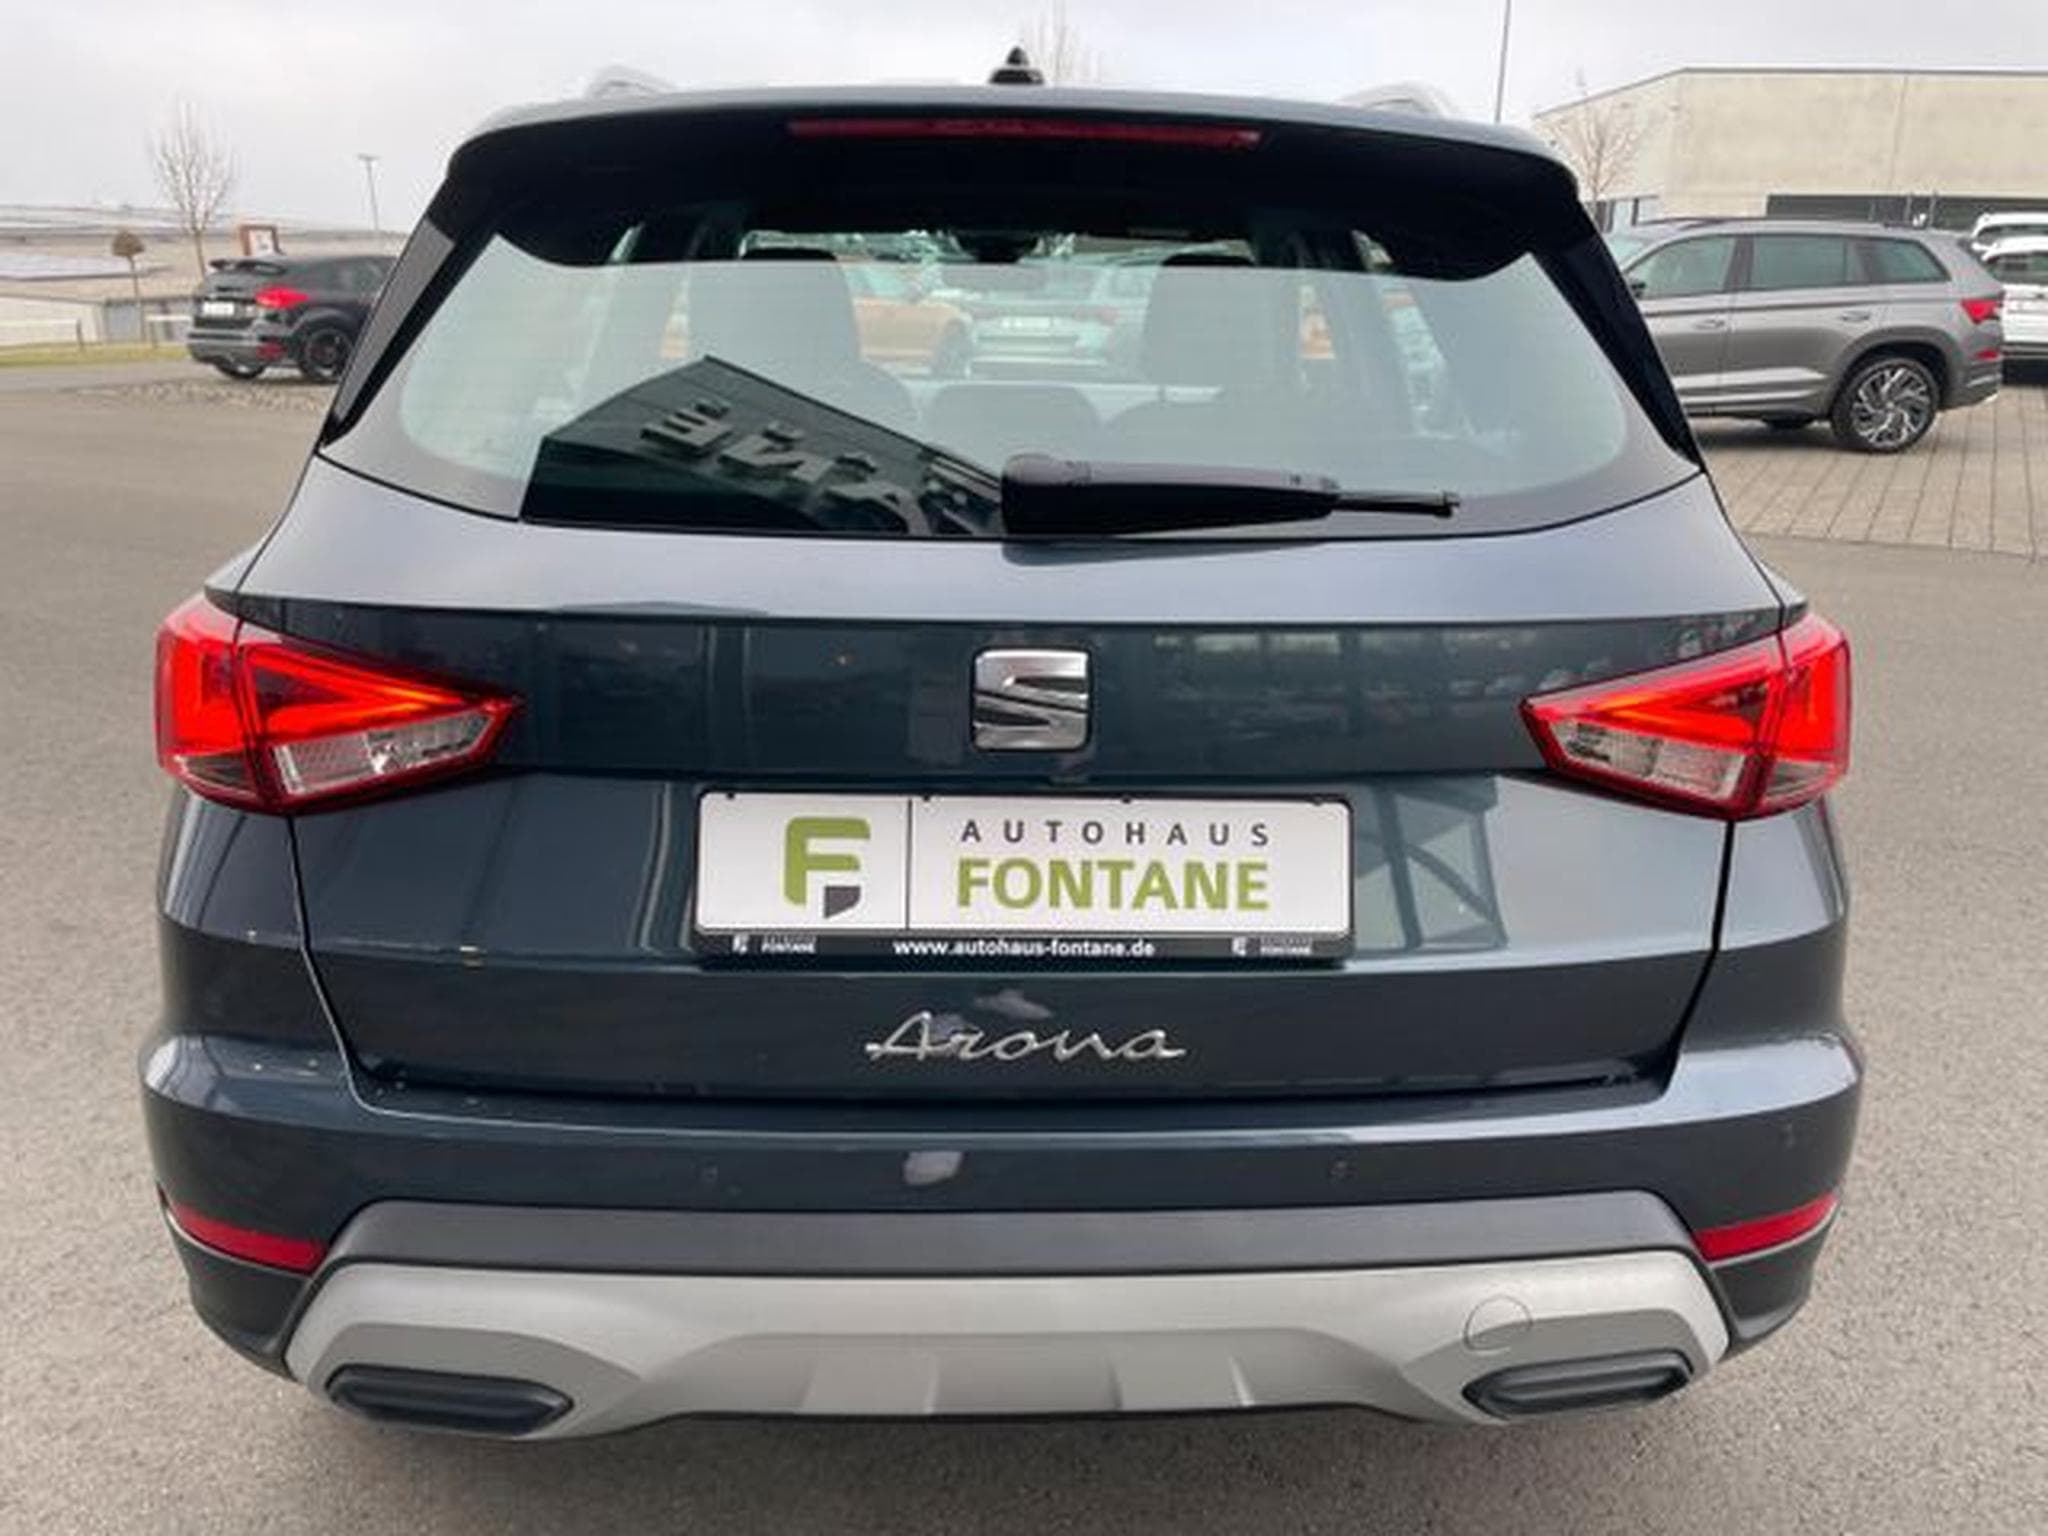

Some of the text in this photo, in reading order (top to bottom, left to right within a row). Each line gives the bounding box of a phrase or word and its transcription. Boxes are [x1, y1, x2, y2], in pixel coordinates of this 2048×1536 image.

[961, 820, 1270, 846] AUTOHAUS
[957, 858, 1269, 910] FONTANE
[893, 940, 1155, 957] www.autohaus-fontane.de
[866, 1011, 1186, 1060] Arona
